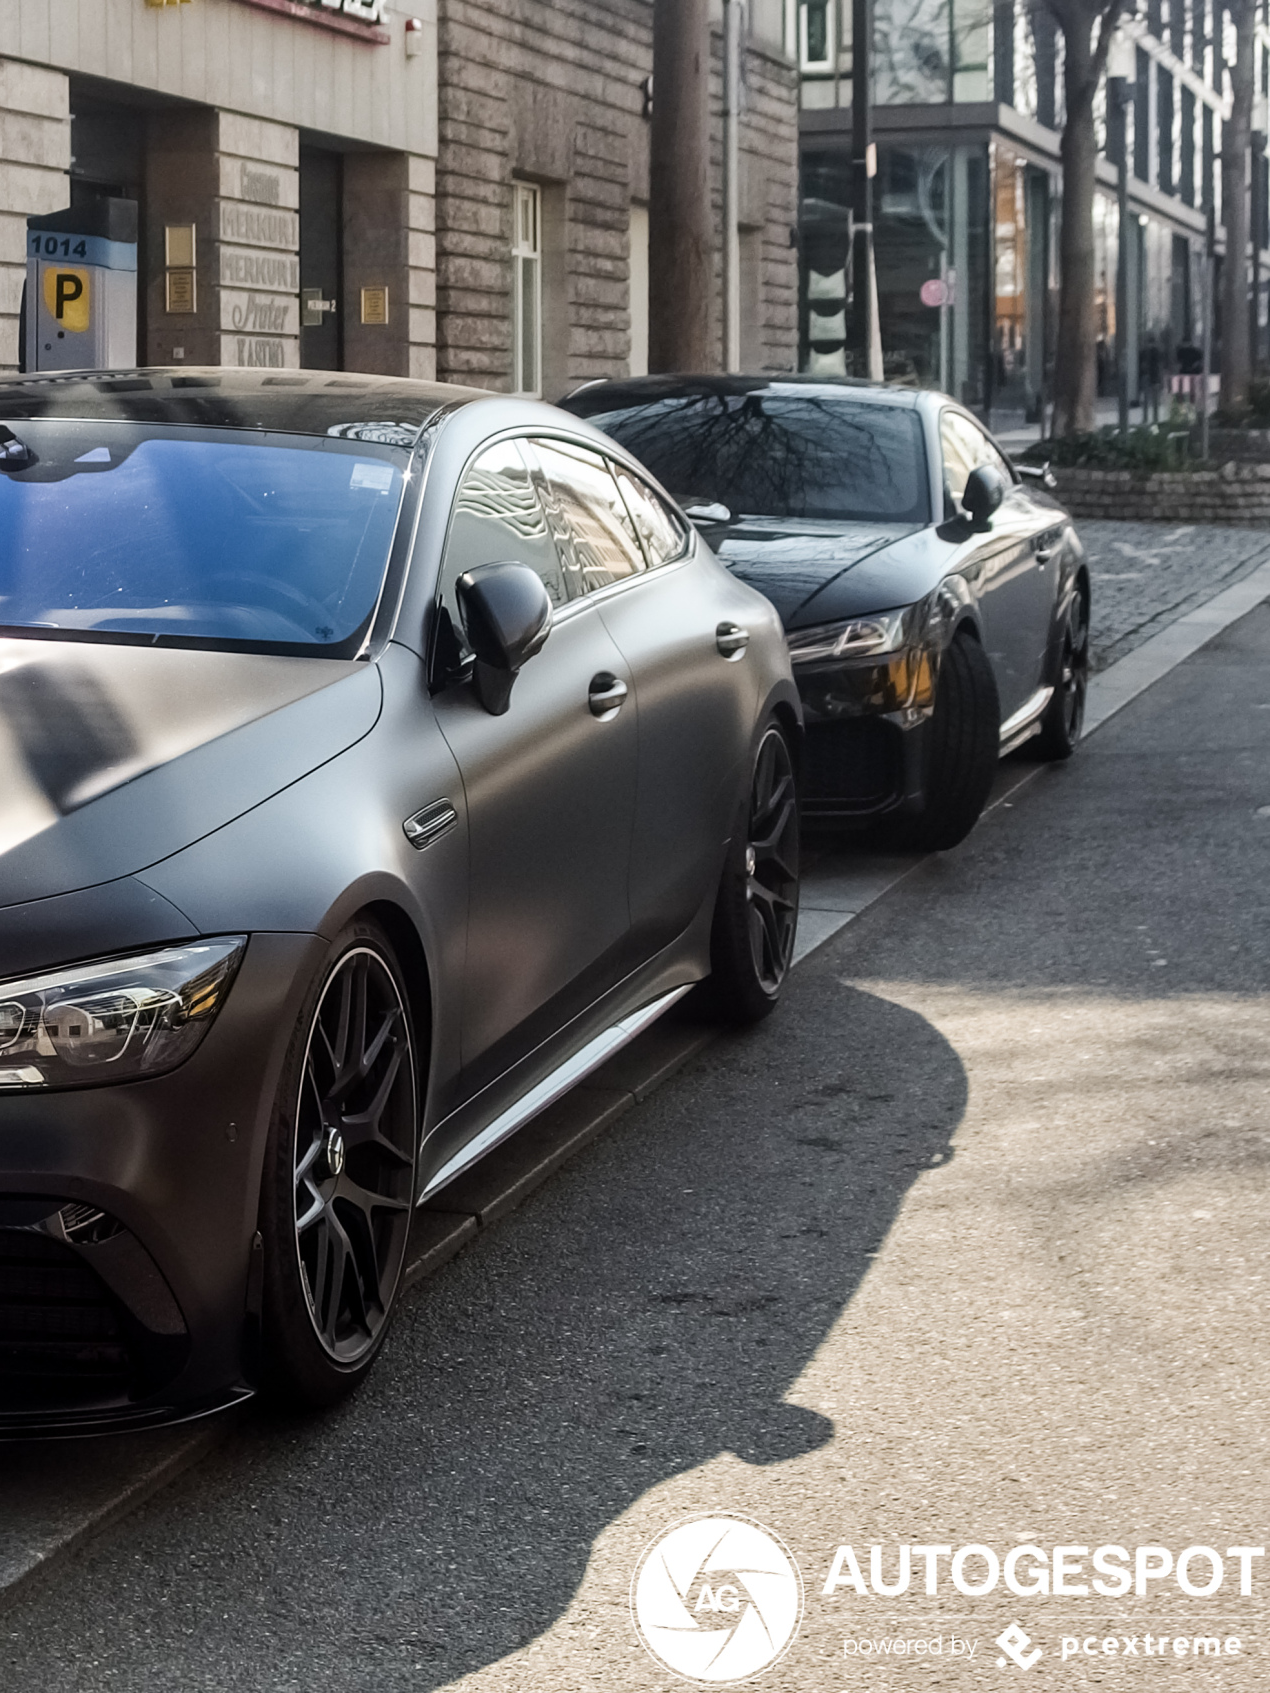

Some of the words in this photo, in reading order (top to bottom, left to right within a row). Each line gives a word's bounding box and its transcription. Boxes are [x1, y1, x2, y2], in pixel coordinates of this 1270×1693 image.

[222, 206, 289, 245] MERKUR
[32, 235, 86, 258] 1014
[221, 252, 289, 288] MERKUR
[56, 274, 83, 319] P
